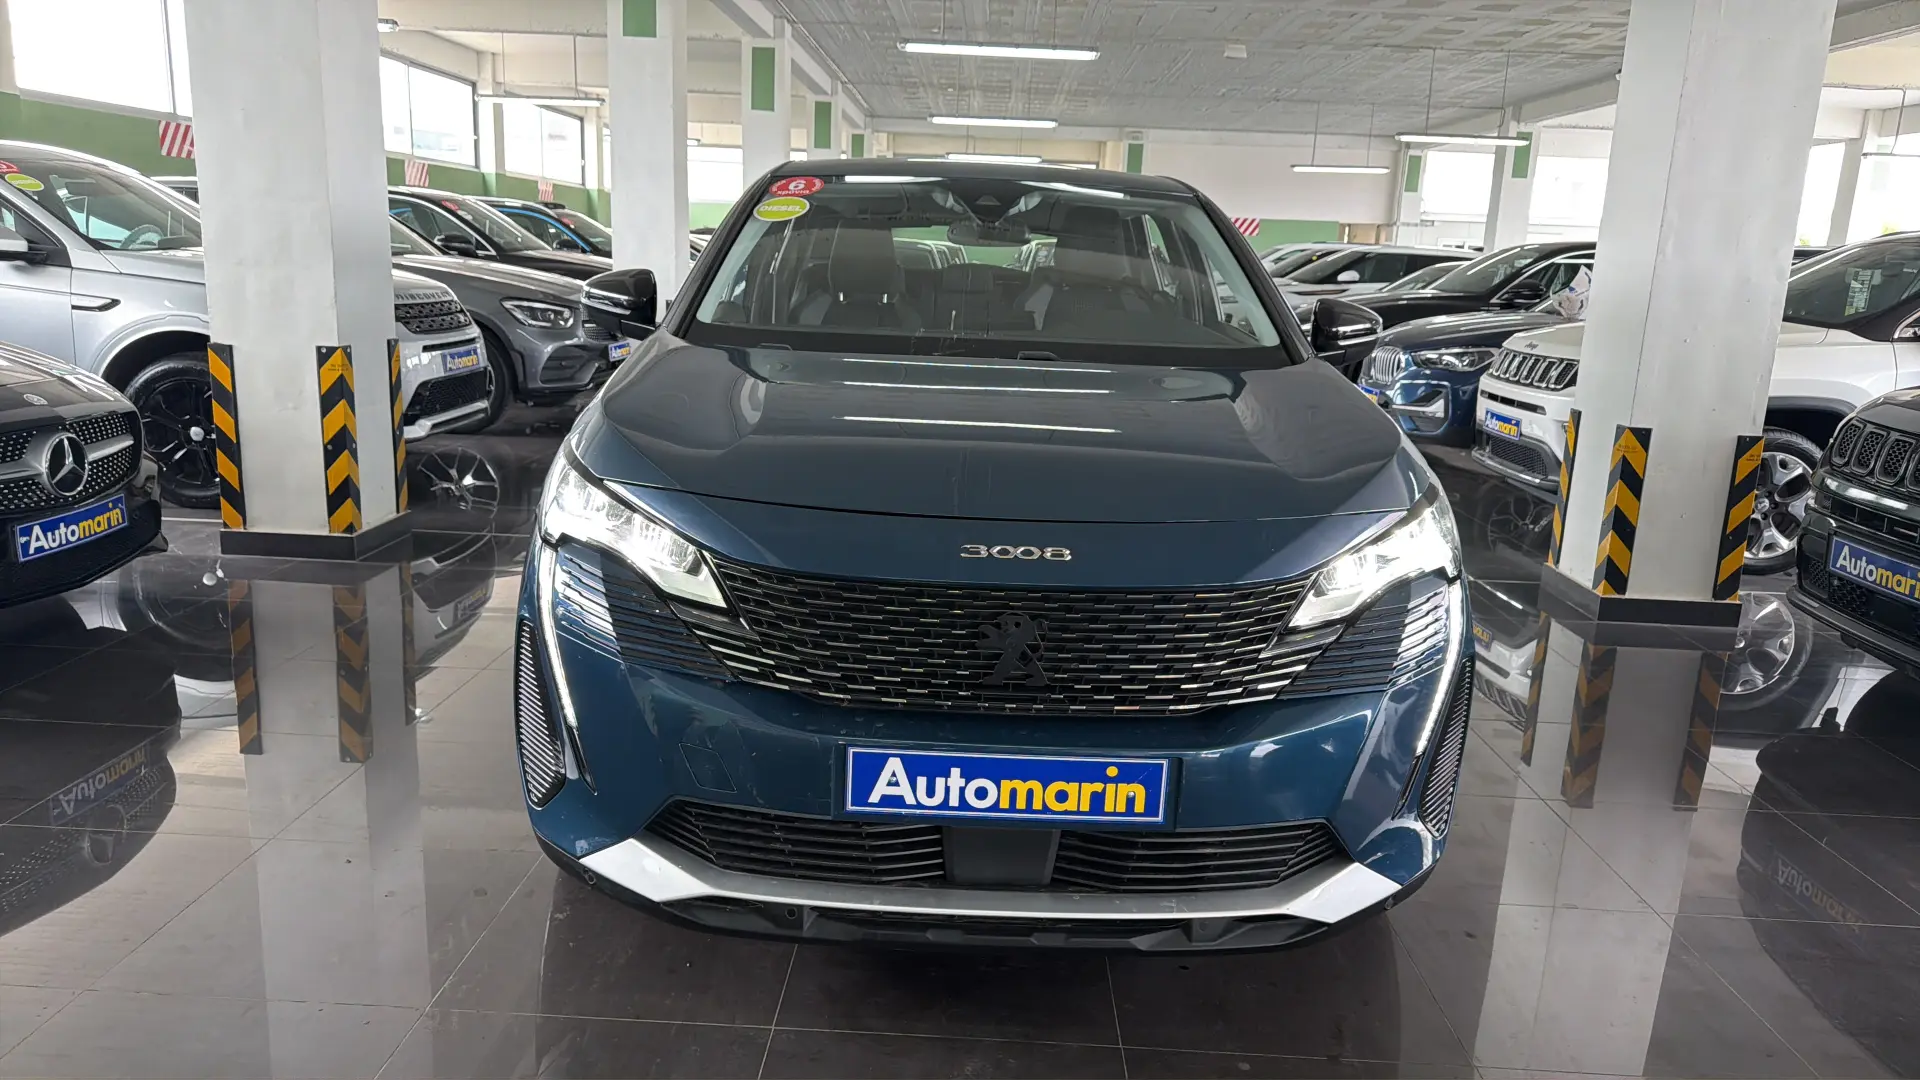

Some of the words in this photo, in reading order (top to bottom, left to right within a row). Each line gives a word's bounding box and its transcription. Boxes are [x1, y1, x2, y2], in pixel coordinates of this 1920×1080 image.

[788, 179, 806, 190] 6
[759, 204, 802, 212] DIESEL
[446, 350, 478, 371] Automarin
[1485, 411, 1518, 436] Automarin
[28, 502, 123, 554] Automarin
[960, 544, 1072, 560] 3008
[867, 756, 1146, 813] Automarin
